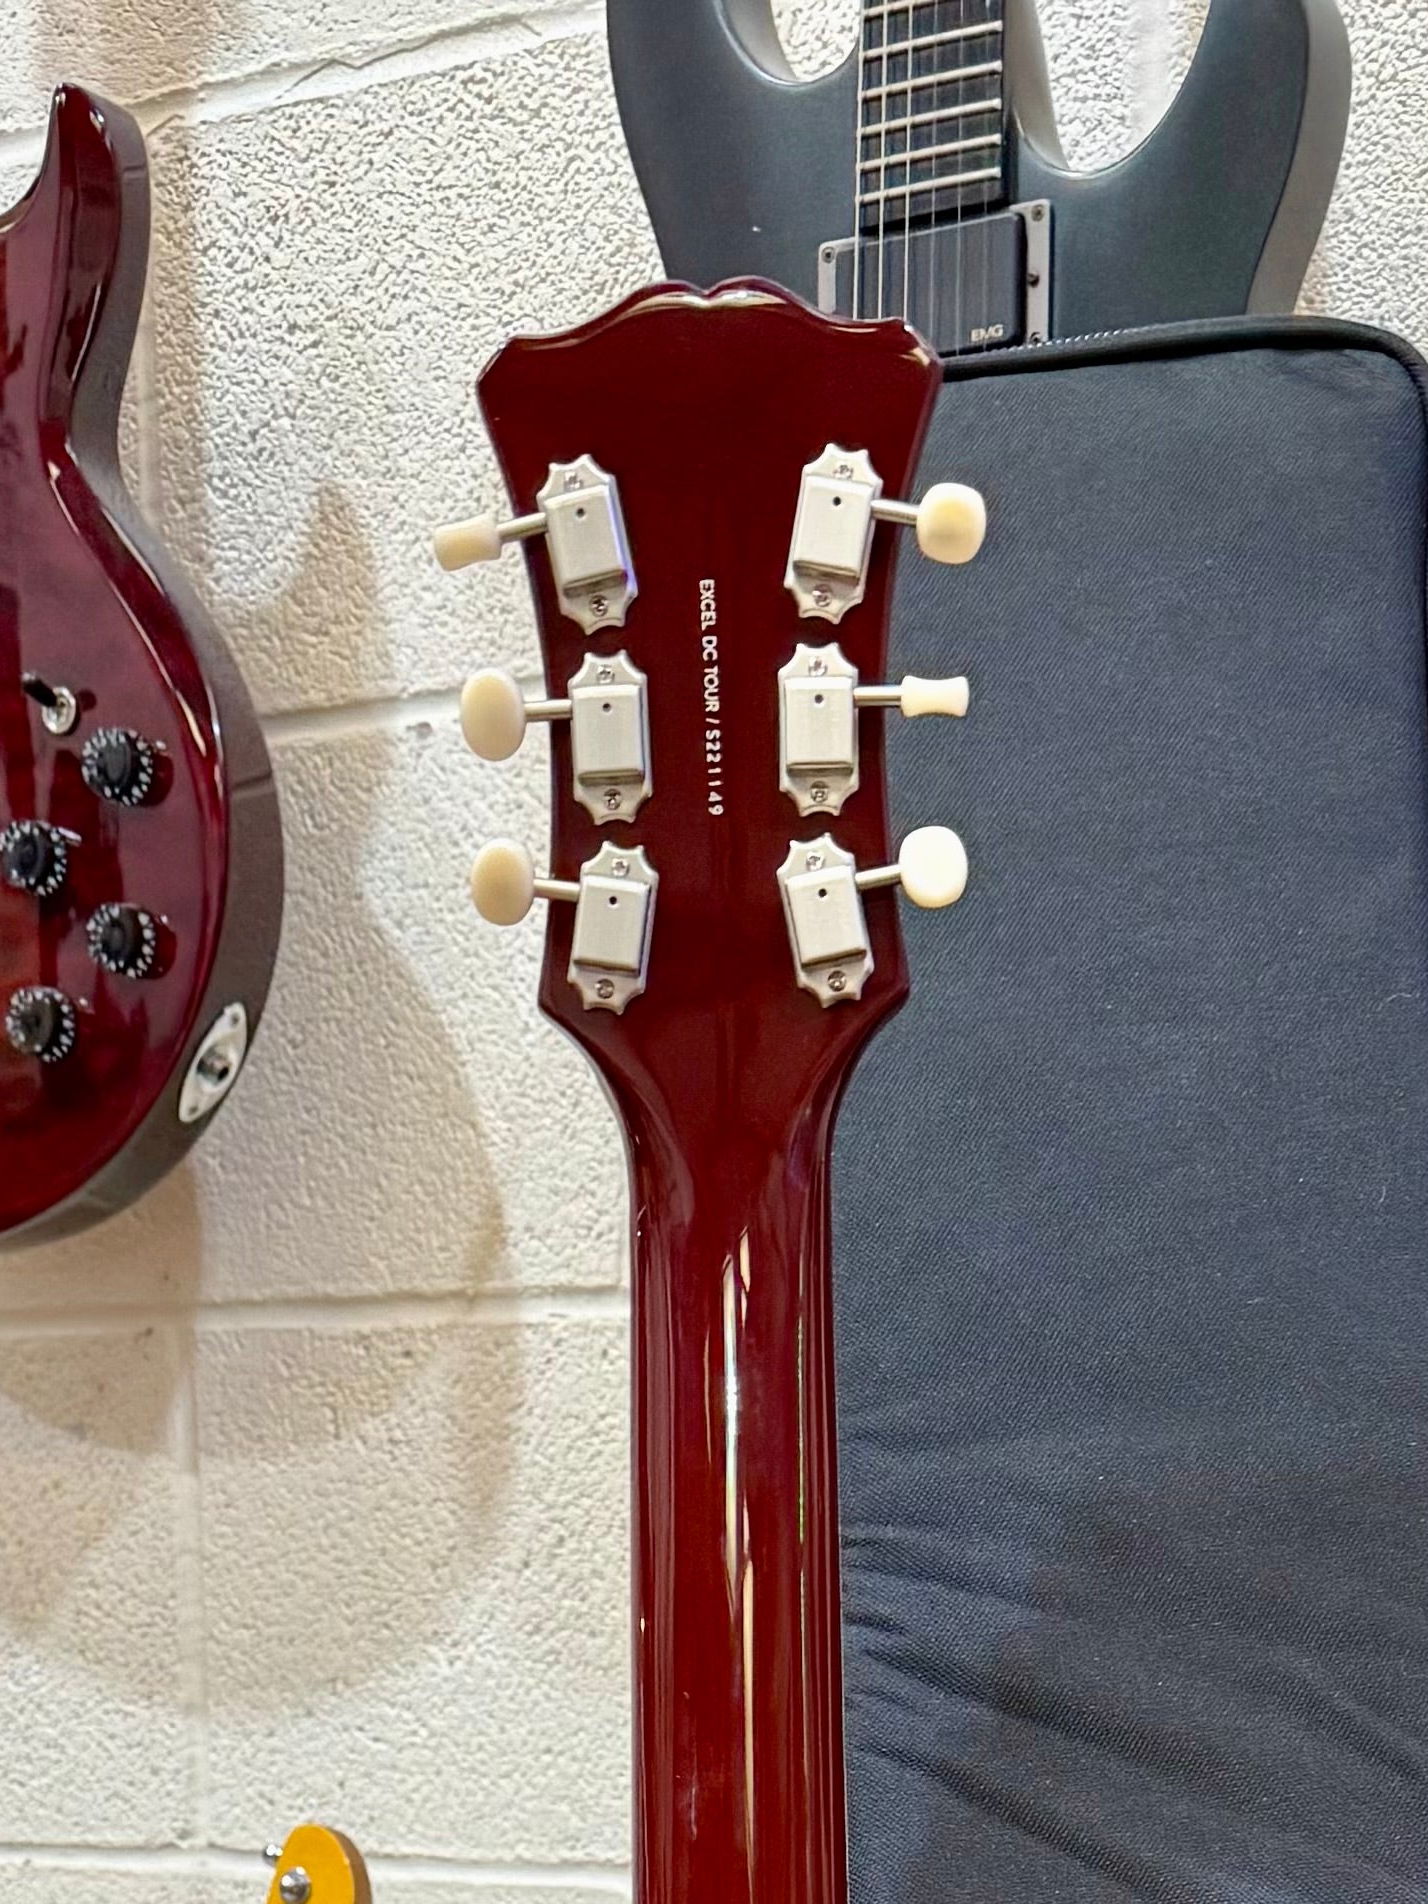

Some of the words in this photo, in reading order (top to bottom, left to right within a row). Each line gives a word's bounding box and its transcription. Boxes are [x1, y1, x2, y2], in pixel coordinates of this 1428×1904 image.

[971, 323, 1004, 342] EMG
[699, 579, 717, 631] EXCEL
[701, 635, 718, 662] DC
[703, 664, 720, 712] TOUR
[705, 729, 724, 816] S221149
